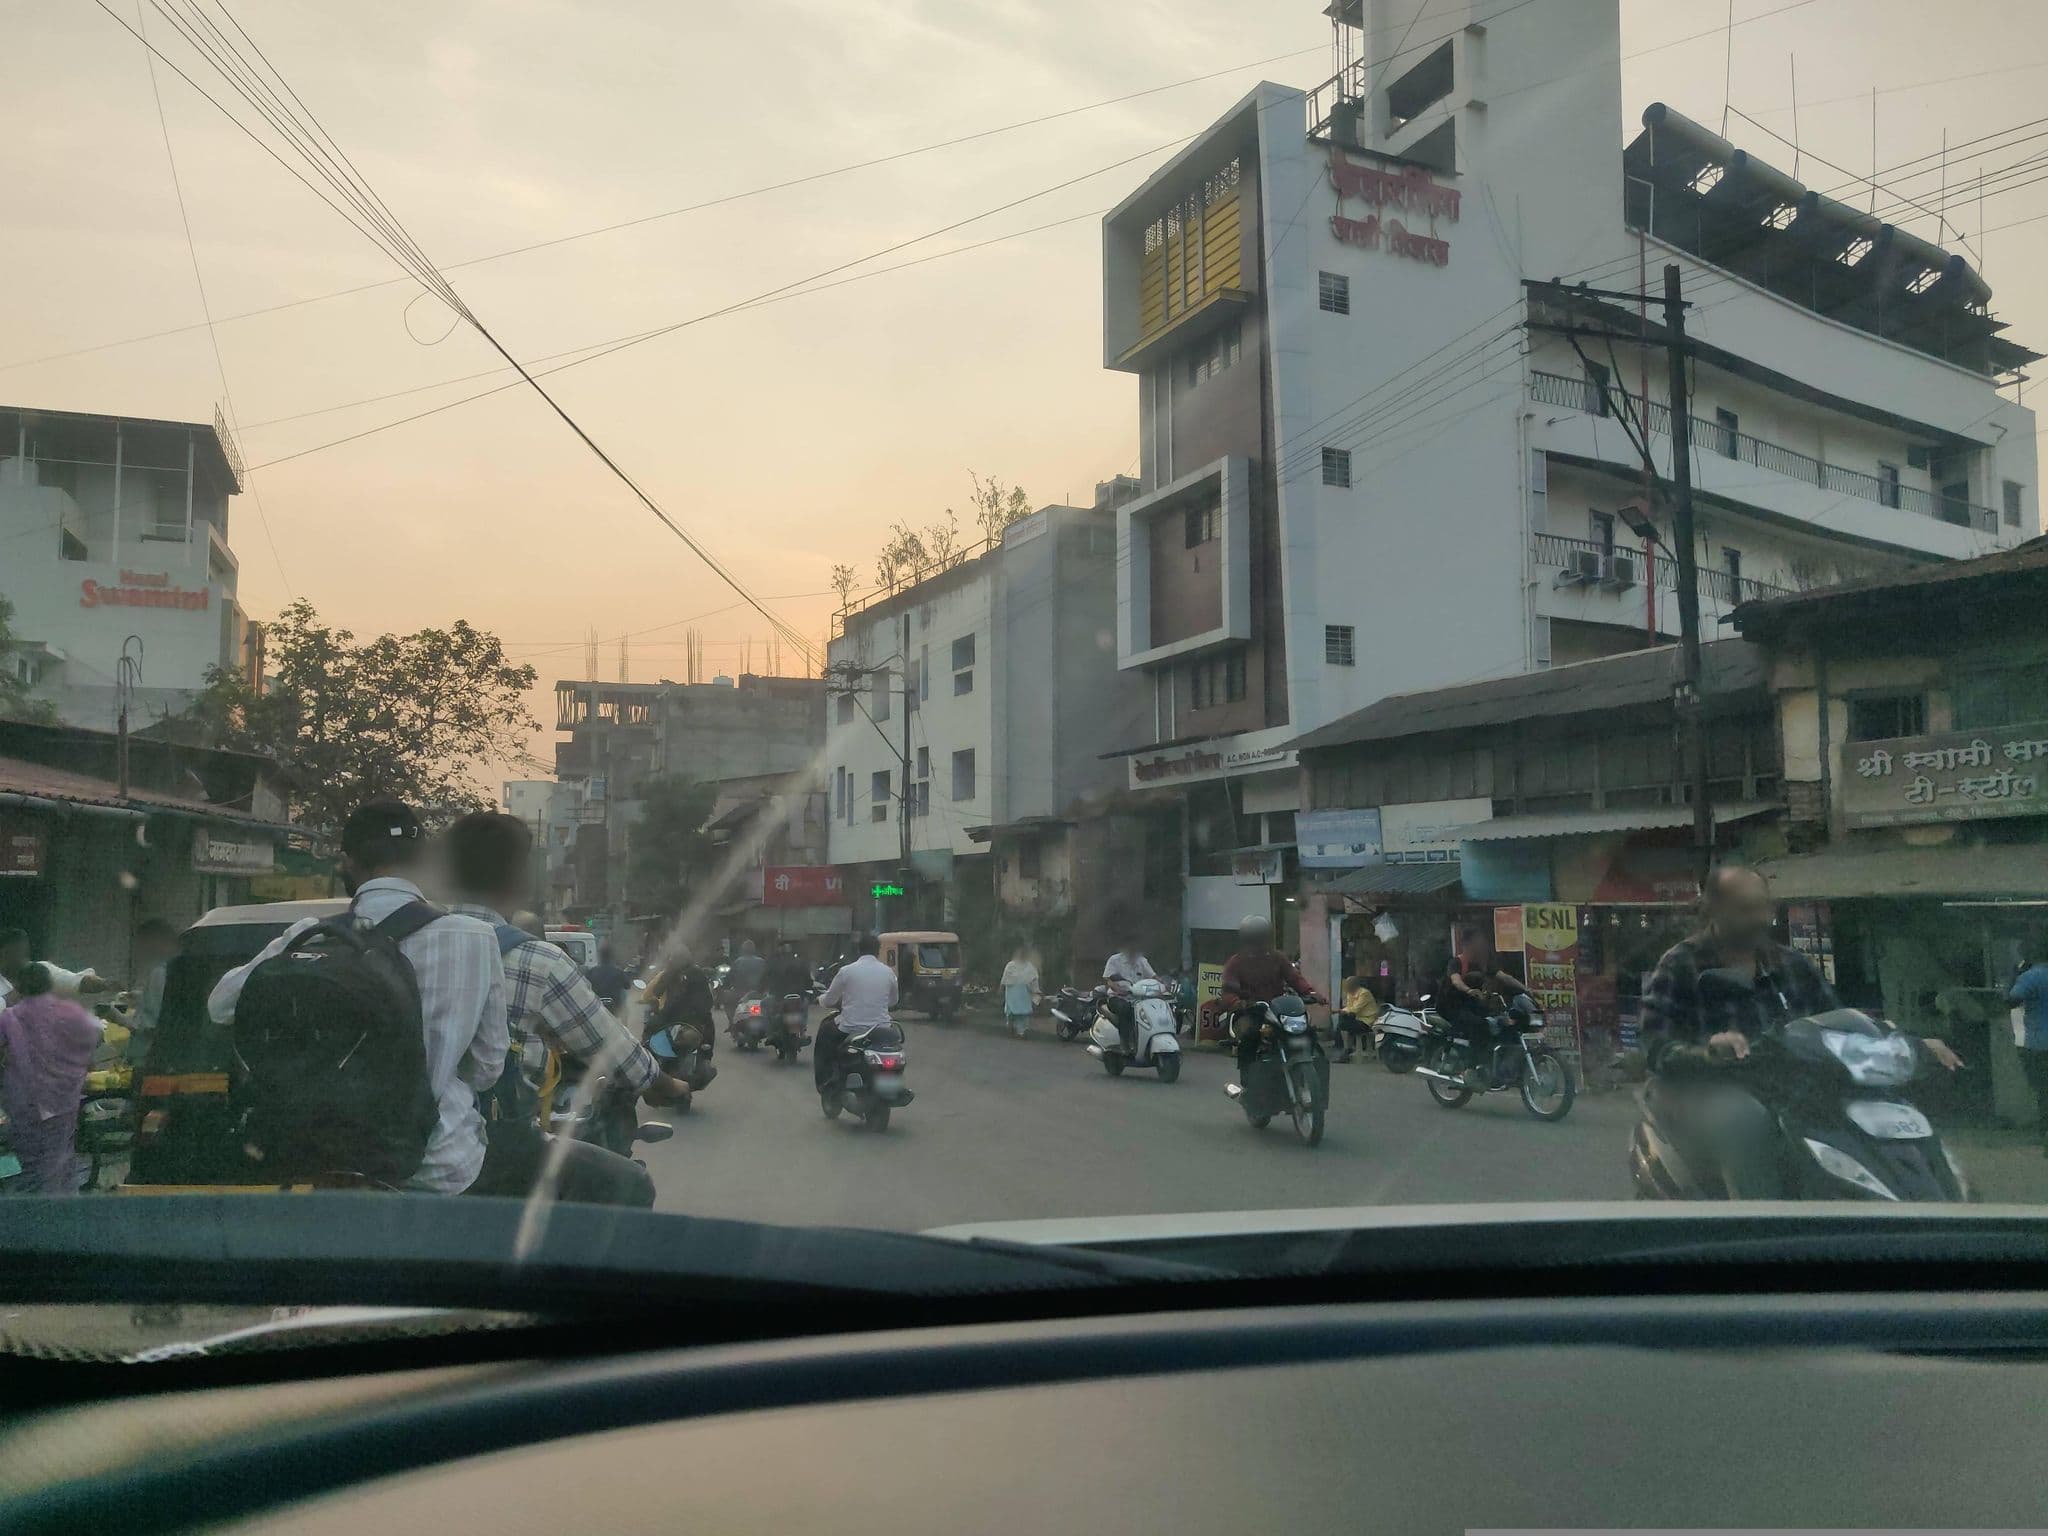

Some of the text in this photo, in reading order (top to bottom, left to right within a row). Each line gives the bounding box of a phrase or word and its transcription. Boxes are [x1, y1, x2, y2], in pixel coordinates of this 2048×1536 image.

[1856, 749, 1894, 777] श्री
[1902, 739, 1992, 773] स्वामी
[1526, 907, 1576, 930] BSNL
